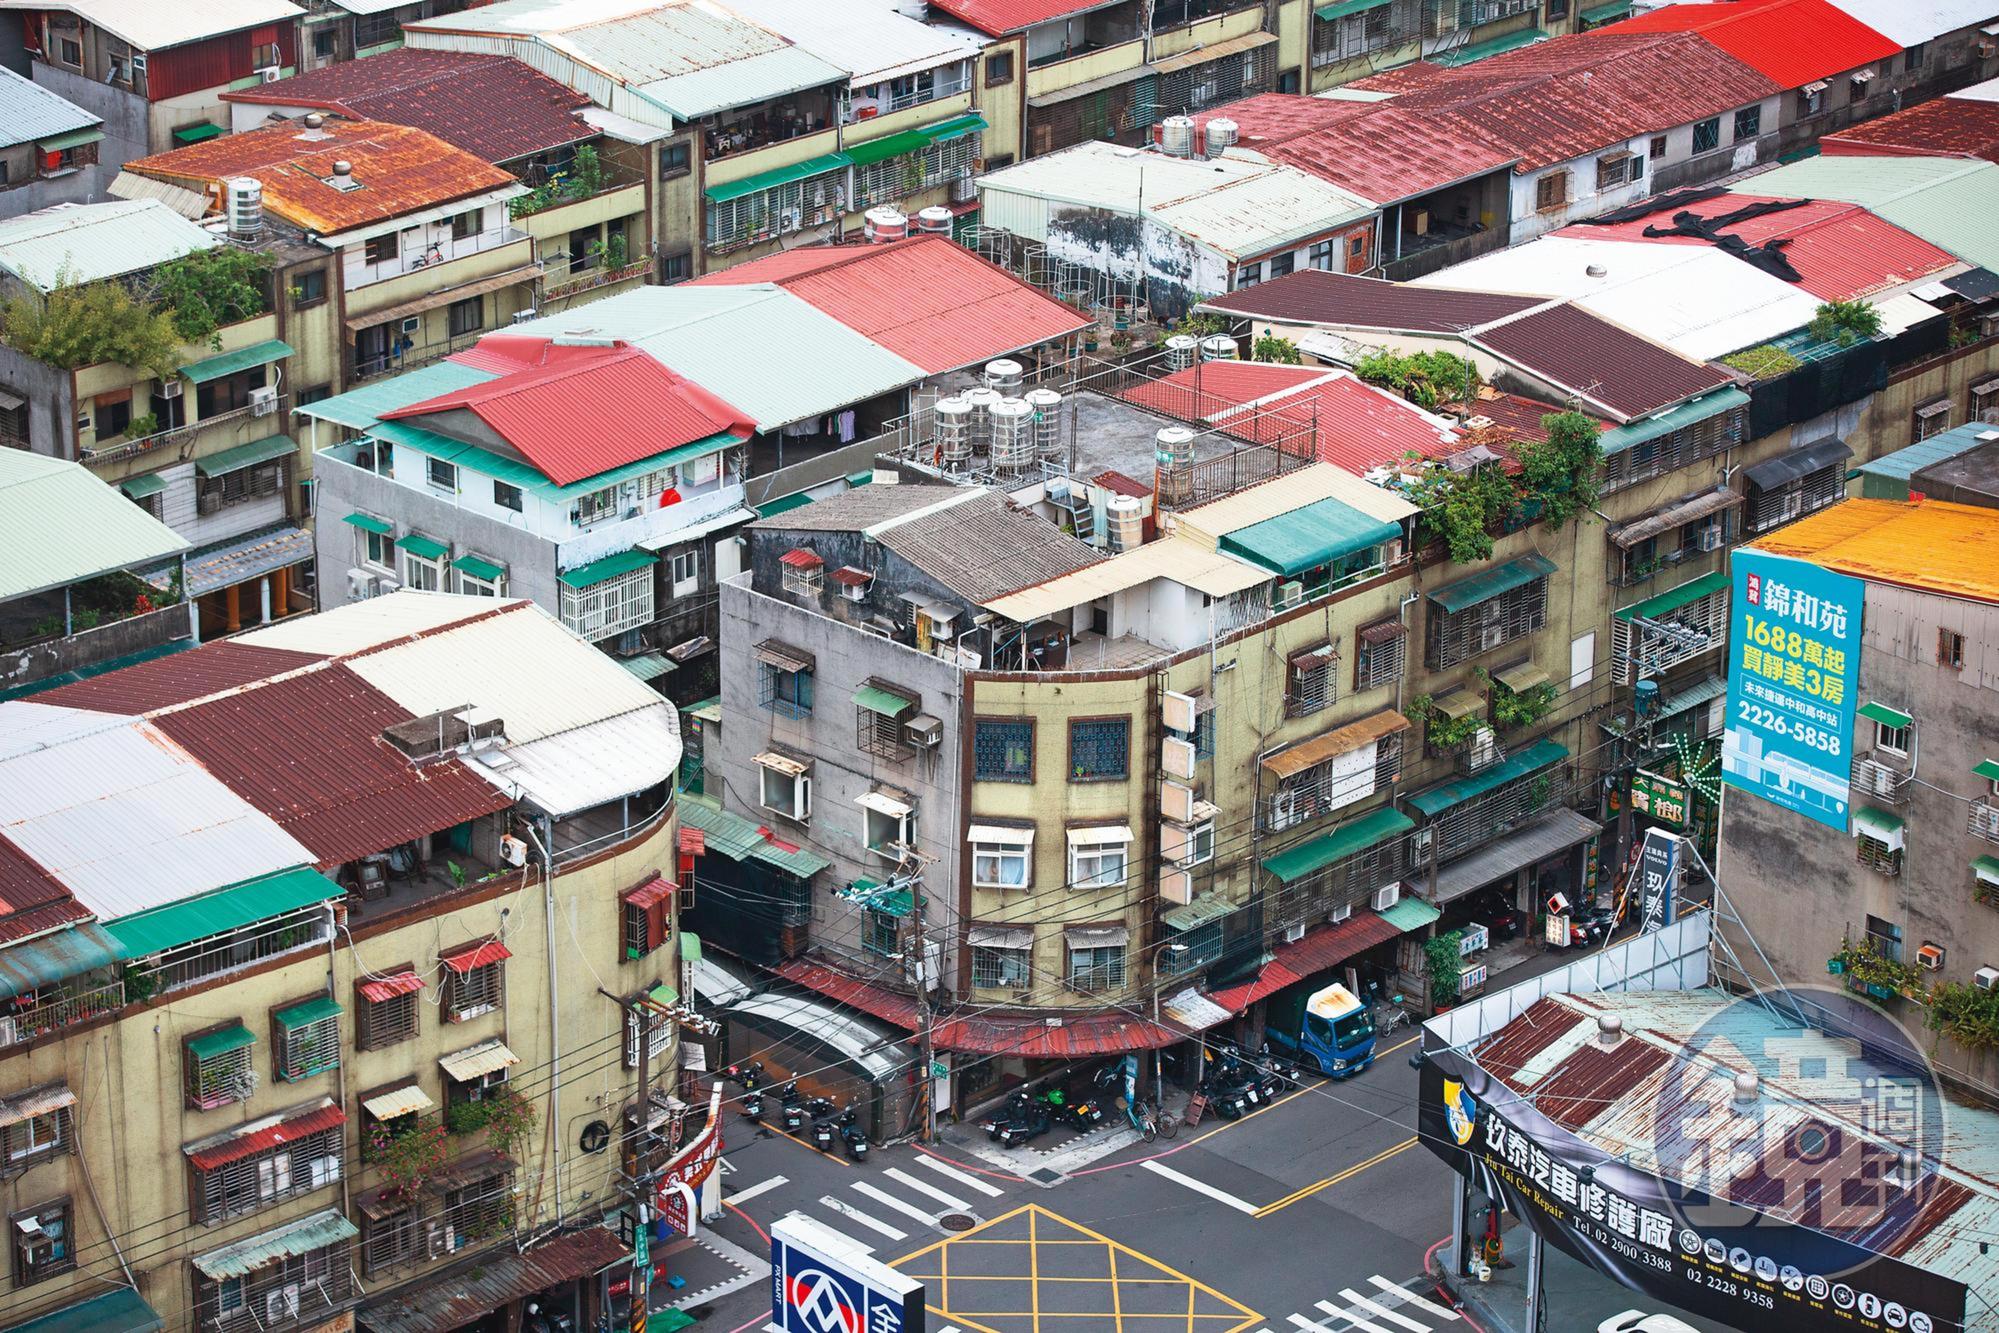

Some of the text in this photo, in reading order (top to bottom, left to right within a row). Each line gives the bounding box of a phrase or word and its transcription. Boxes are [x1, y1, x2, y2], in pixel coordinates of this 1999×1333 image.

[1764, 579, 1847, 640] 錦和苑
[1742, 643, 1844, 705] 買靜美3房
[1745, 614, 1845, 676] 1688萬起
[1738, 700, 1841, 756] 2226-5858
[1484, 1153, 1564, 1219] Jiu Tai Car Repair
[1486, 1112, 1673, 1253] 玖泰汽車修護廠
[1611, 1237, 1637, 1259] 2900
[1642, 1251, 1672, 1273] 3388
[1687, 1268, 1702, 1283] 02
[1707, 1275, 1737, 1297] 2228
[1743, 1288, 1774, 1310] 9358
